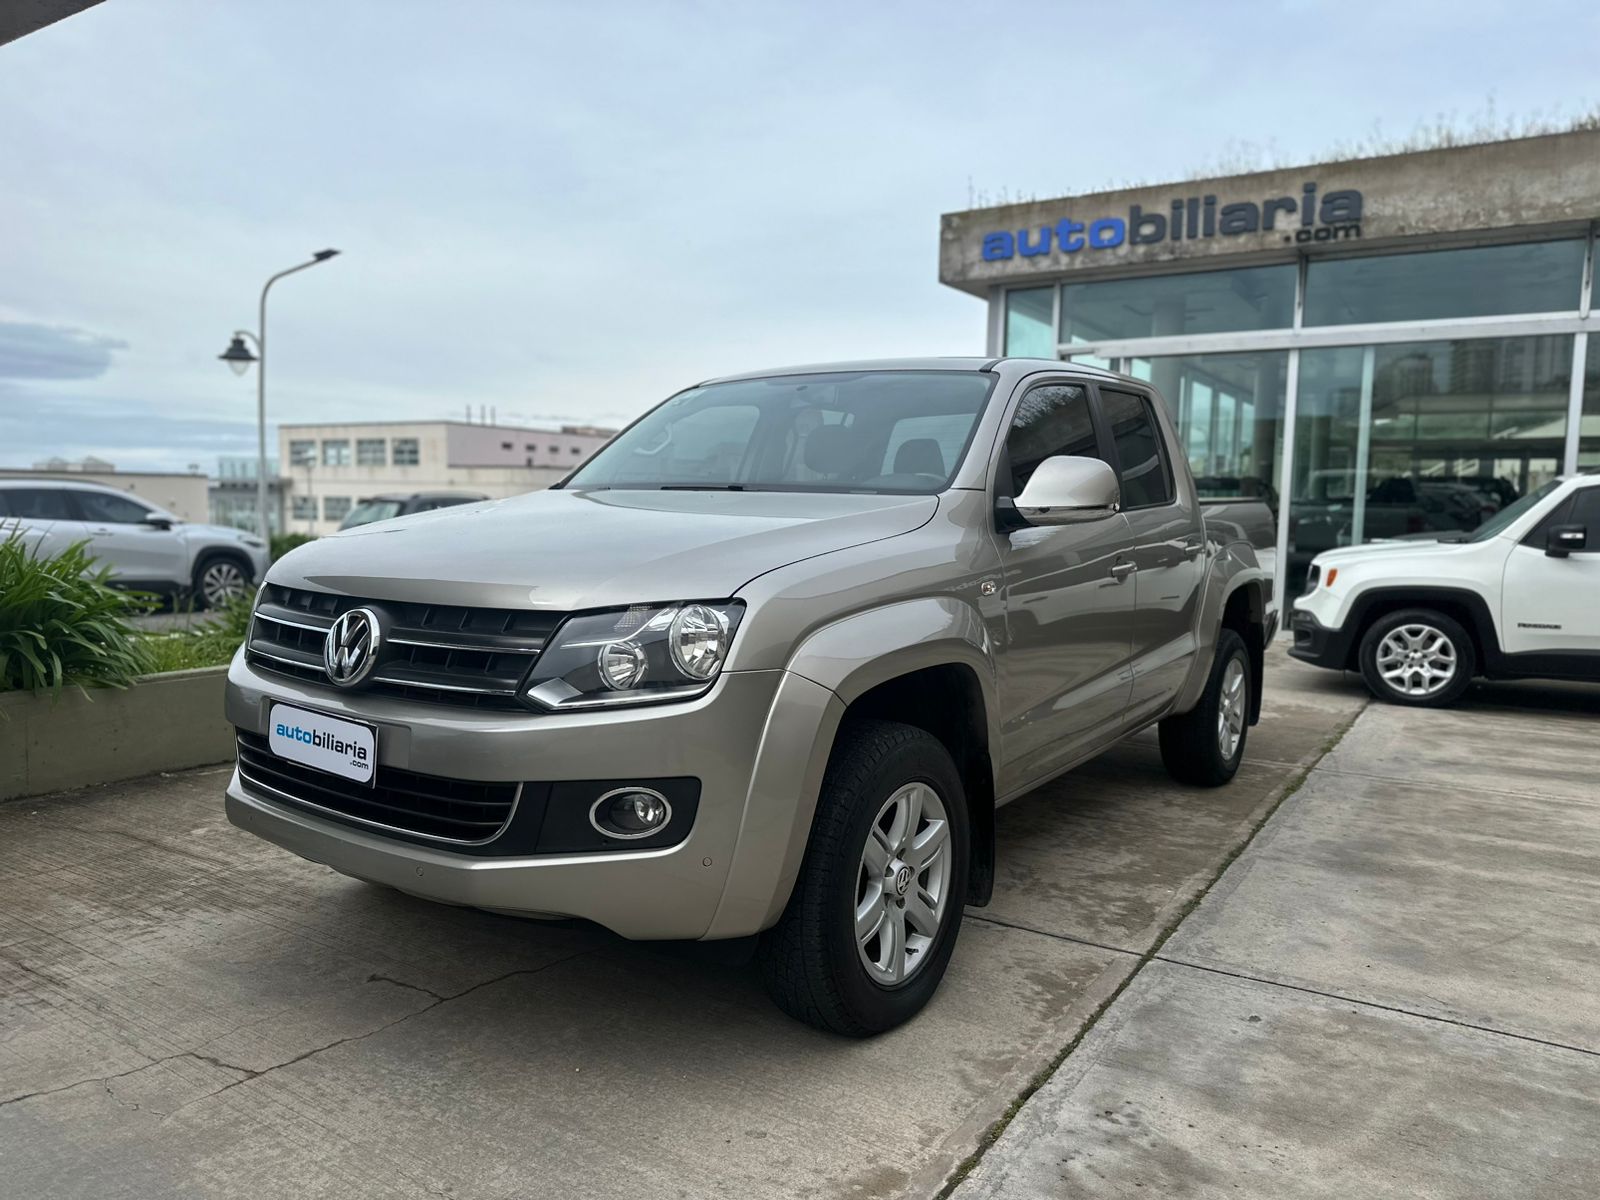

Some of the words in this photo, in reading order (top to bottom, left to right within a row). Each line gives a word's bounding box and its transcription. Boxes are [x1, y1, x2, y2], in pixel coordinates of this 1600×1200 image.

[981, 182, 1364, 262] autobiliaria
[1284, 221, 1362, 243] .com
[276, 723, 367, 761] autobiliaria
[349, 759, 369, 770] .com
